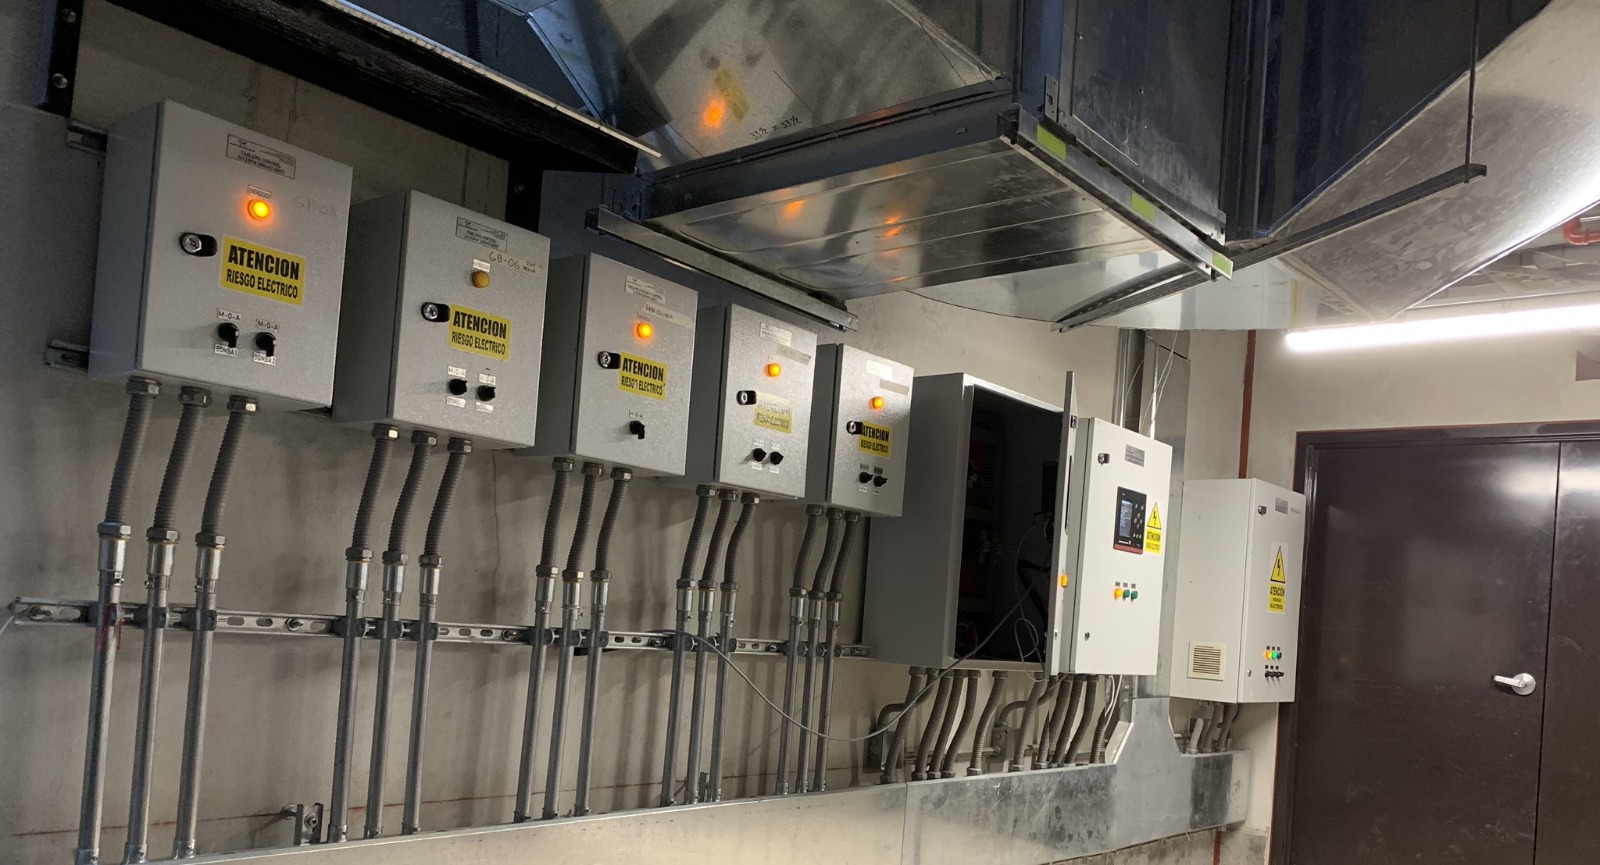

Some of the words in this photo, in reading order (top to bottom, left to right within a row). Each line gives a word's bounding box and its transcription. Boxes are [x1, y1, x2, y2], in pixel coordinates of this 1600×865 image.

[228, 244, 300, 281] ATENCION
[226, 268, 256, 289] RIESGO
[257, 276, 298, 299] ELECTRICO
[453, 310, 507, 339] ATENCION
[451, 331, 474, 348] RIESGO
[474, 336, 506, 355] ELECTRICO
[622, 357, 664, 382] ATENCION
[638, 379, 663, 396] ELECTRICO
